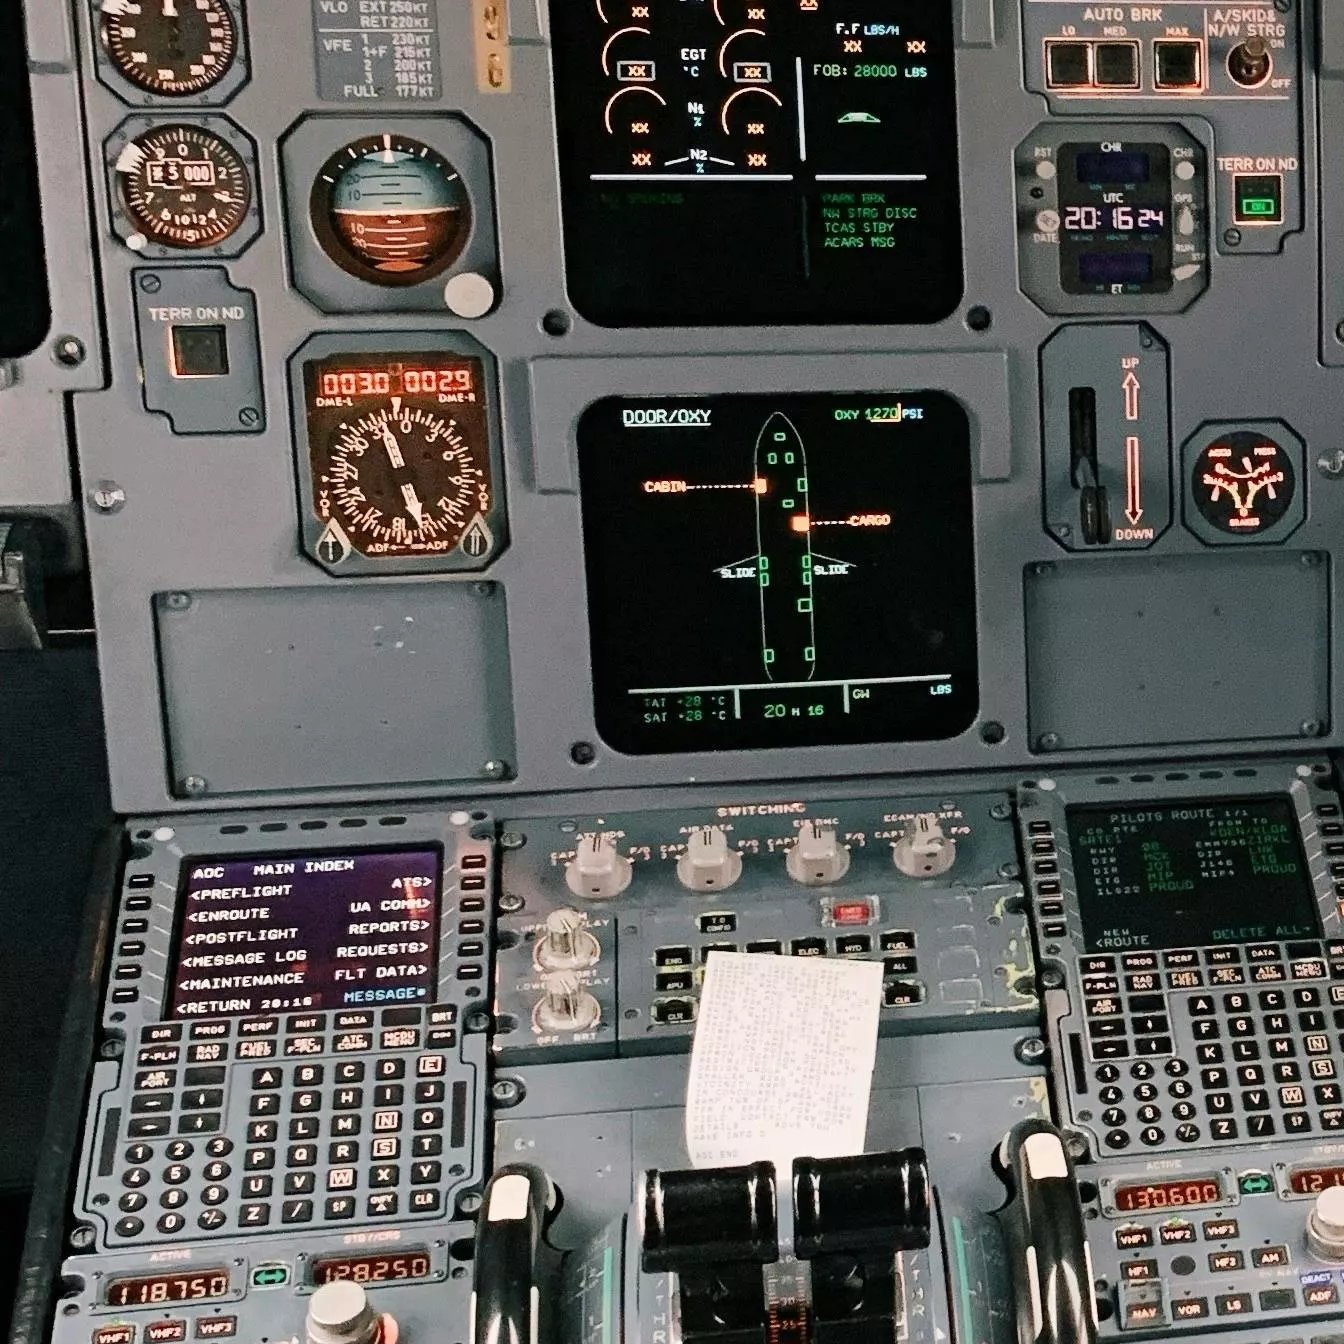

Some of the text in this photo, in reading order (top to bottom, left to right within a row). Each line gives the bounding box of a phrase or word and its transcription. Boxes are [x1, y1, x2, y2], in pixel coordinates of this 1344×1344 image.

[320, 0, 428, 15] VLO EXT 250KT
[360, 15, 428, 29] RET 220KT
[1084, 9, 1162, 22] AUTO BRK
[1213, 9, 1276, 23] A/SKID&
[836, 23, 900, 36] F.F LBS/H
[1104, 26, 1127, 36] MED
[1208, 24, 1285, 37] N/W STRG
[323, 34, 431, 53] VFE 230KT
[681, 49, 706, 61] EGT
[813, 64, 928, 79] FOB: 28000 LBS
[1271, 79, 1291, 89] OFF
[344, 85, 434, 98] FULL 177KT
[1217, 158, 1297, 172] TERR ON ND
[1103, 193, 1123, 203] UTC
[1065, 206, 1164, 230] 20:16 24
[824, 223, 894, 234] TCAS STBY
[824, 237, 895, 248] ACARS MSG
[149, 306, 245, 321] TERR ON ND
[1121, 358, 1140, 369] UP
[315, 397, 353, 409] DME-L
[439, 393, 477, 405] DME-R
[623, 408, 712, 426] DOOR/OXY
[834, 406, 924, 421] OXY 1270 PSI
[644, 481, 687, 494] CABIN
[850, 514, 891, 528] CARGO
[1115, 528, 1154, 541] DOWN
[814, 564, 849, 577] SLIDE
[930, 684, 952, 696] LBS
[717, 803, 806, 816] SWITCHING
[1111, 809, 1214, 823] PILOTS ROUTE
[254, 863, 295, 876] MAIN
[305, 859, 354, 872] INDEX
[1253, 863, 1297, 875] PROUD
[1149, 880, 1194, 892] PROUD
[1213, 926, 1300, 940] DELETE ALL
[275, 949, 307, 962] LOG
[335, 967, 365, 981] FLT
[344, 987, 416, 1002] MESSAGE
[415, 1193, 433, 1206] CLR
[1163, 1229, 1190, 1240] VHF2
[1133, 1307, 1156, 1318] NAV
[1177, 1304, 1201, 1315] VOR
[98, 1332, 130, 1343] VHF1
[150, 1326, 181, 1338] VHF2
